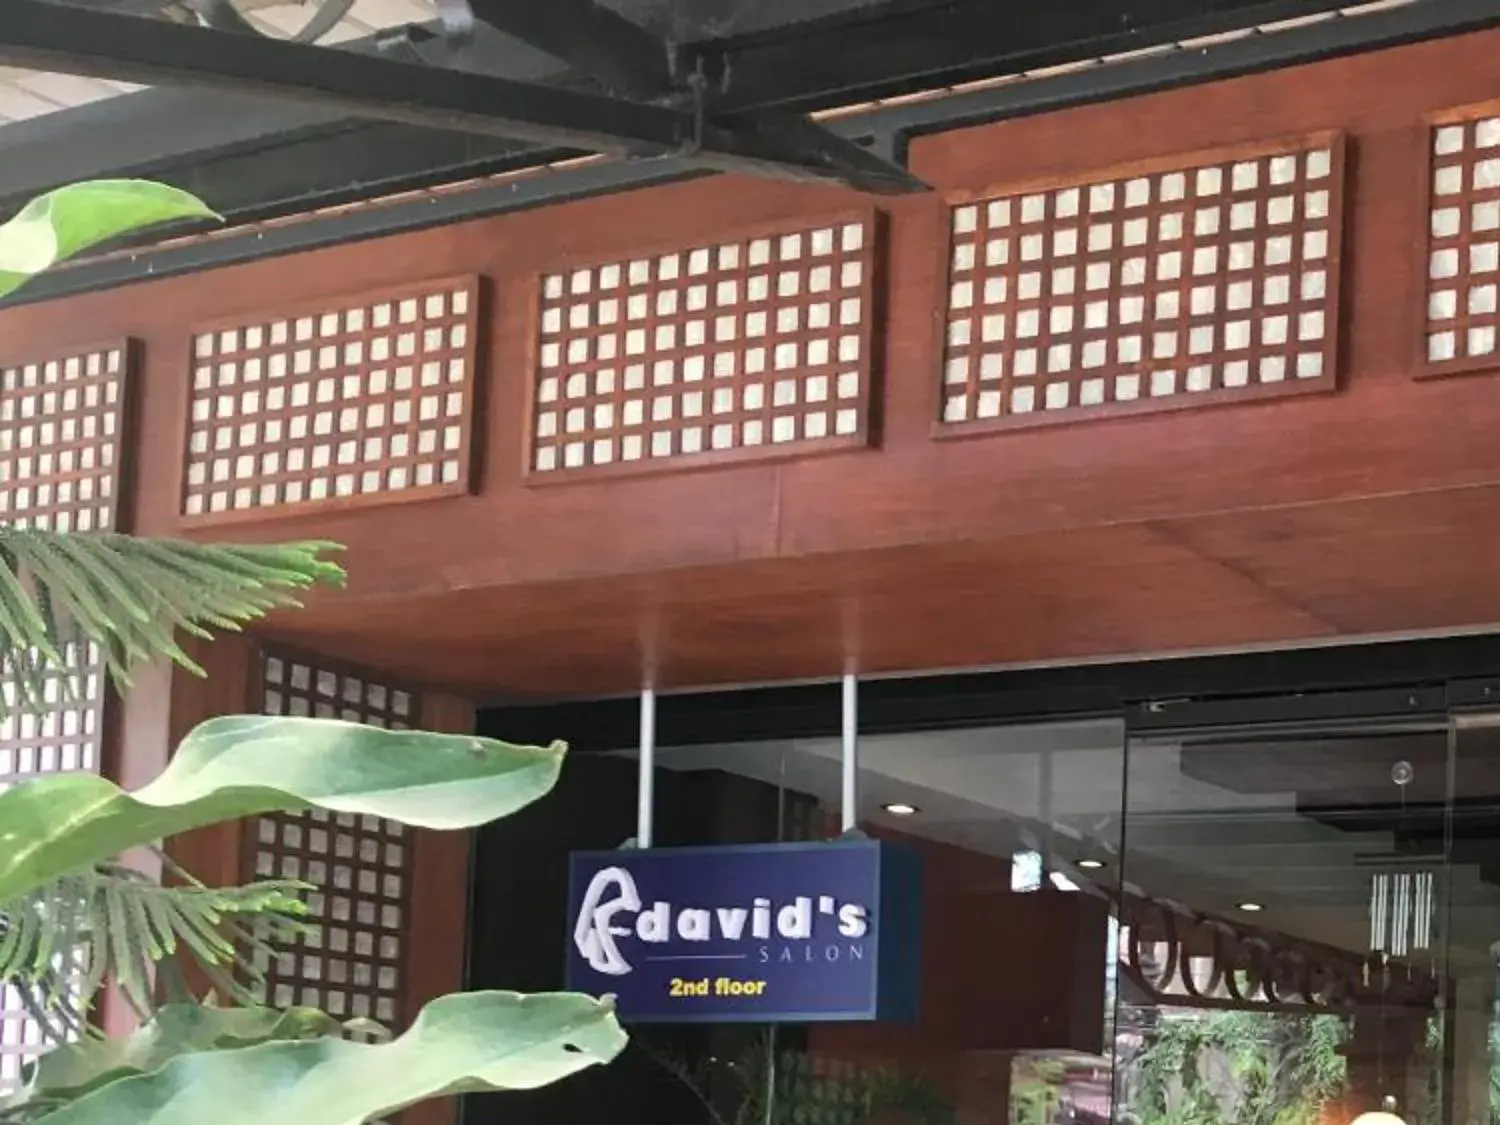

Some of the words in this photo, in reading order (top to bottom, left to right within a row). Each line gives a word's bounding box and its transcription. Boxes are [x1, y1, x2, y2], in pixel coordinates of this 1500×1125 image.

[635, 895, 869, 943] david's
[757, 945, 865, 964] SALON
[669, 977, 709, 997] 2nd
[714, 976, 767, 996] floor
